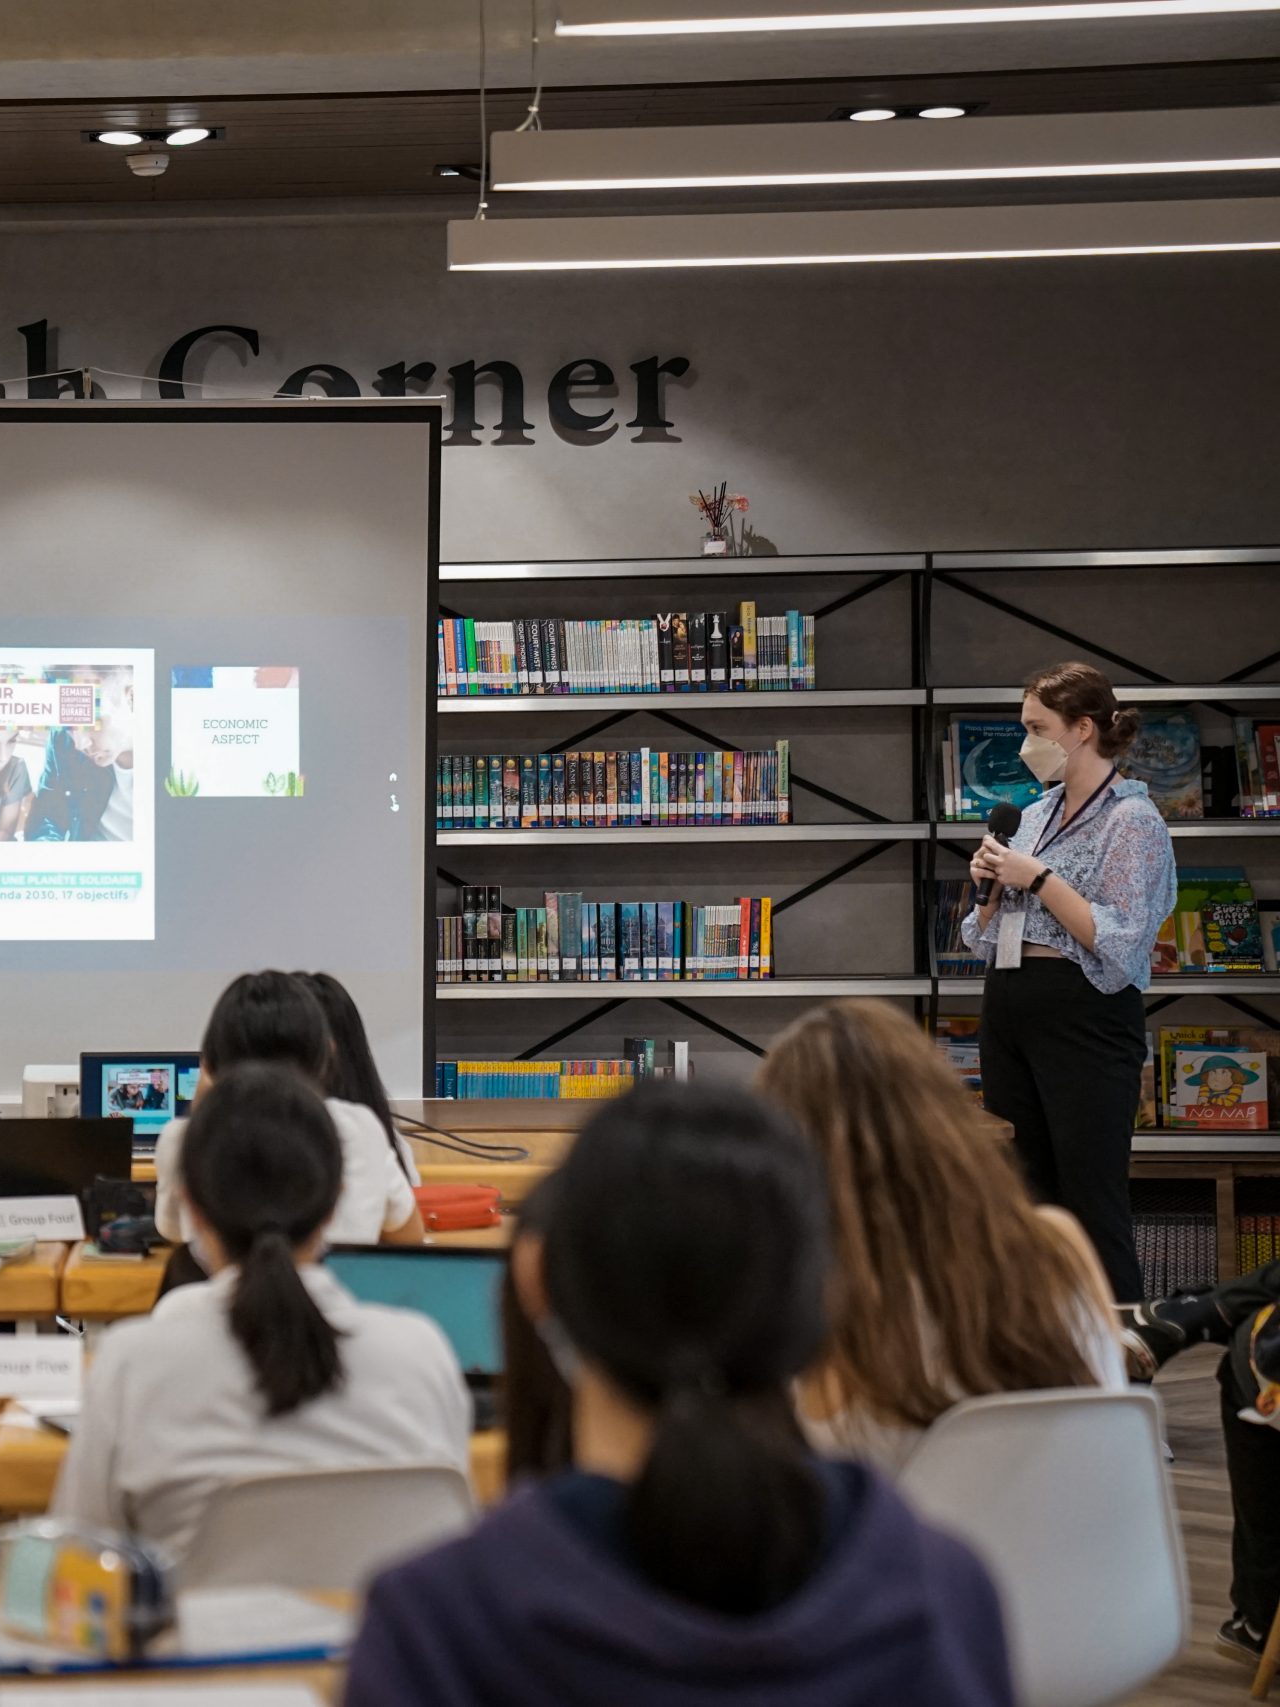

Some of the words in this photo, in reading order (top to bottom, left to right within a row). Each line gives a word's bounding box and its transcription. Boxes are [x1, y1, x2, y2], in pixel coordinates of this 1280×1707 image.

[61, 687, 91, 697] SEMAINE
[61, 707, 91, 716] DURABLE
[203, 719, 269, 729] ECONOMIC
[211, 734, 260, 744] ASPECT
[1, 875, 25, 886] UNE
[78, 875, 137, 886] SOLIDAIRE
[25, 890, 58, 901] 2030,
[62, 890, 73, 900] 17
[76, 890, 129, 902] objectifs
[1189, 1107, 1215, 1118] NO
[1220, 1106, 1257, 1119] NAP
[8, 1214, 46, 1226] Group
[48, 1213, 75, 1224] Four
